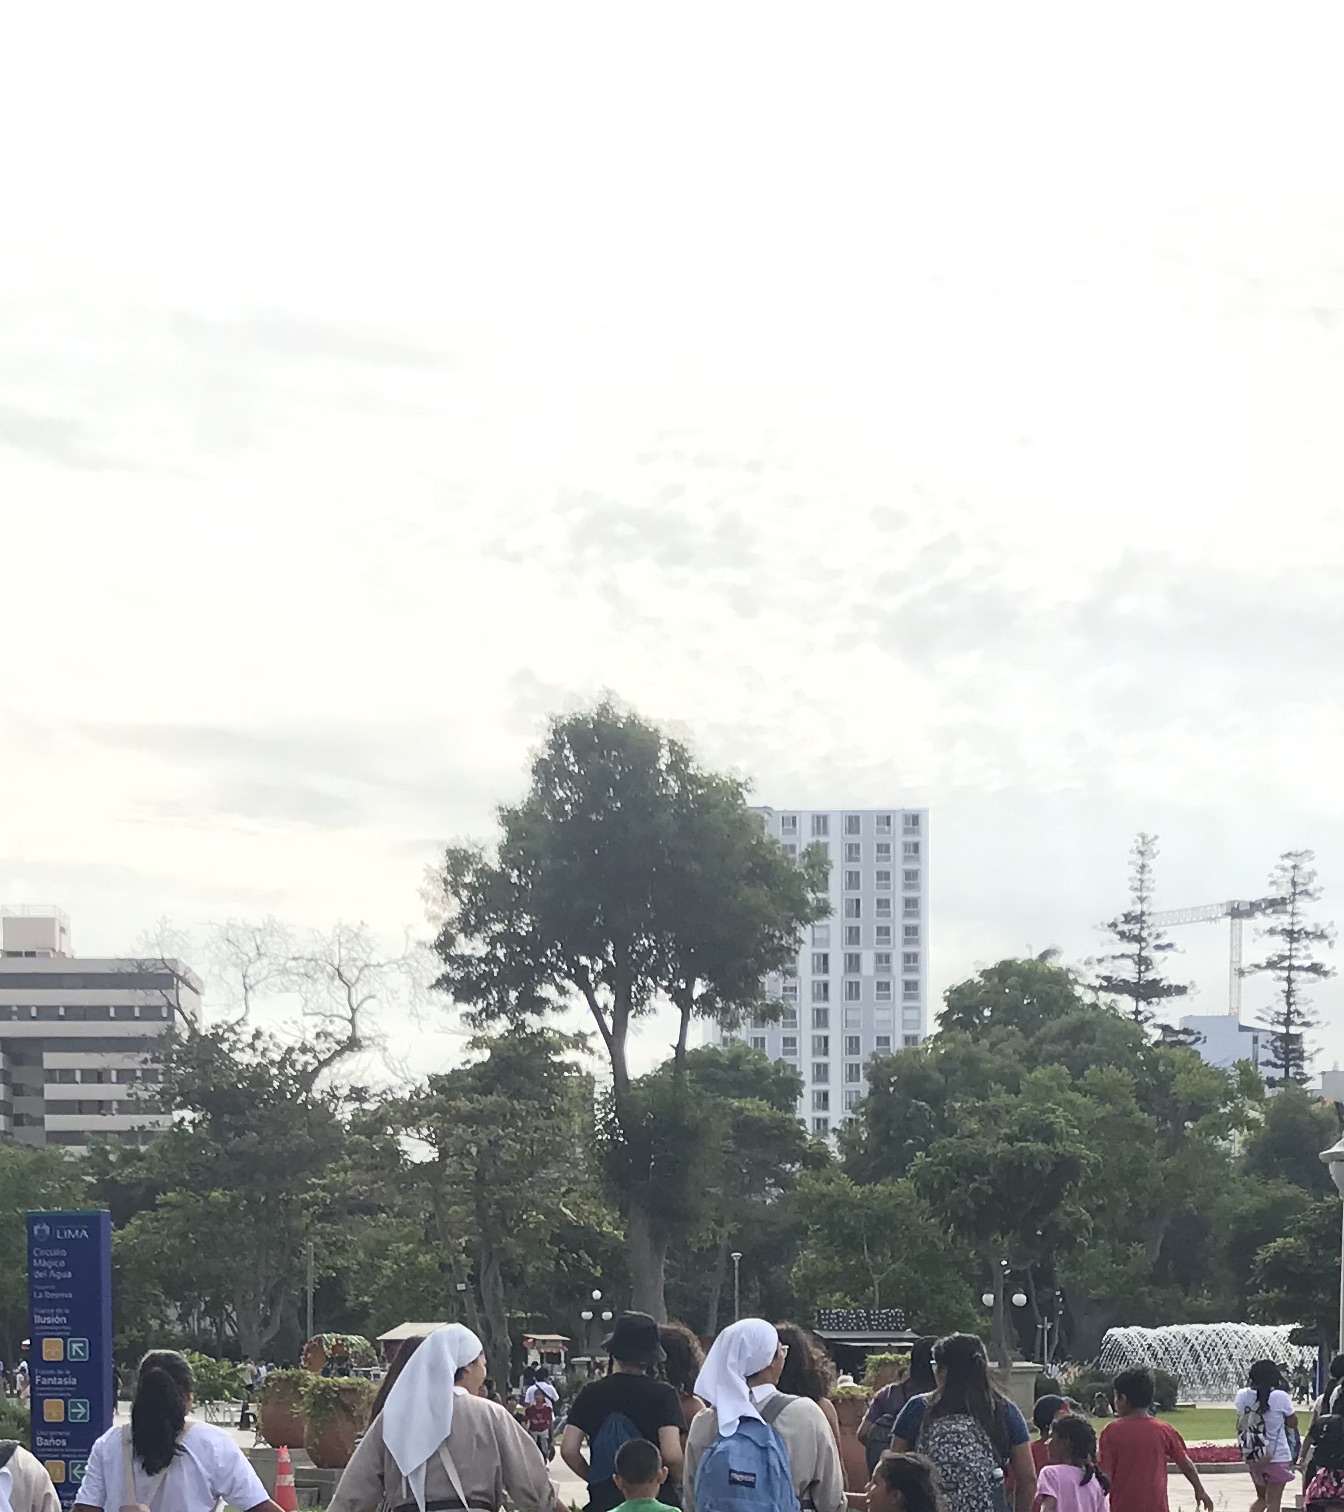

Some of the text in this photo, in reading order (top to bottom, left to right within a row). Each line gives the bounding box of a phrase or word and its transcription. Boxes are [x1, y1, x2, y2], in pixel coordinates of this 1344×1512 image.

[56, 1229, 89, 1240] LIMA
[33, 1247, 67, 1257] Circuito
[34, 1269, 72, 1280] del Agua
[34, 1314, 67, 1325] Ilusión
[35, 1375, 77, 1386] Fantasía
[36, 1436, 67, 1447] Baños
